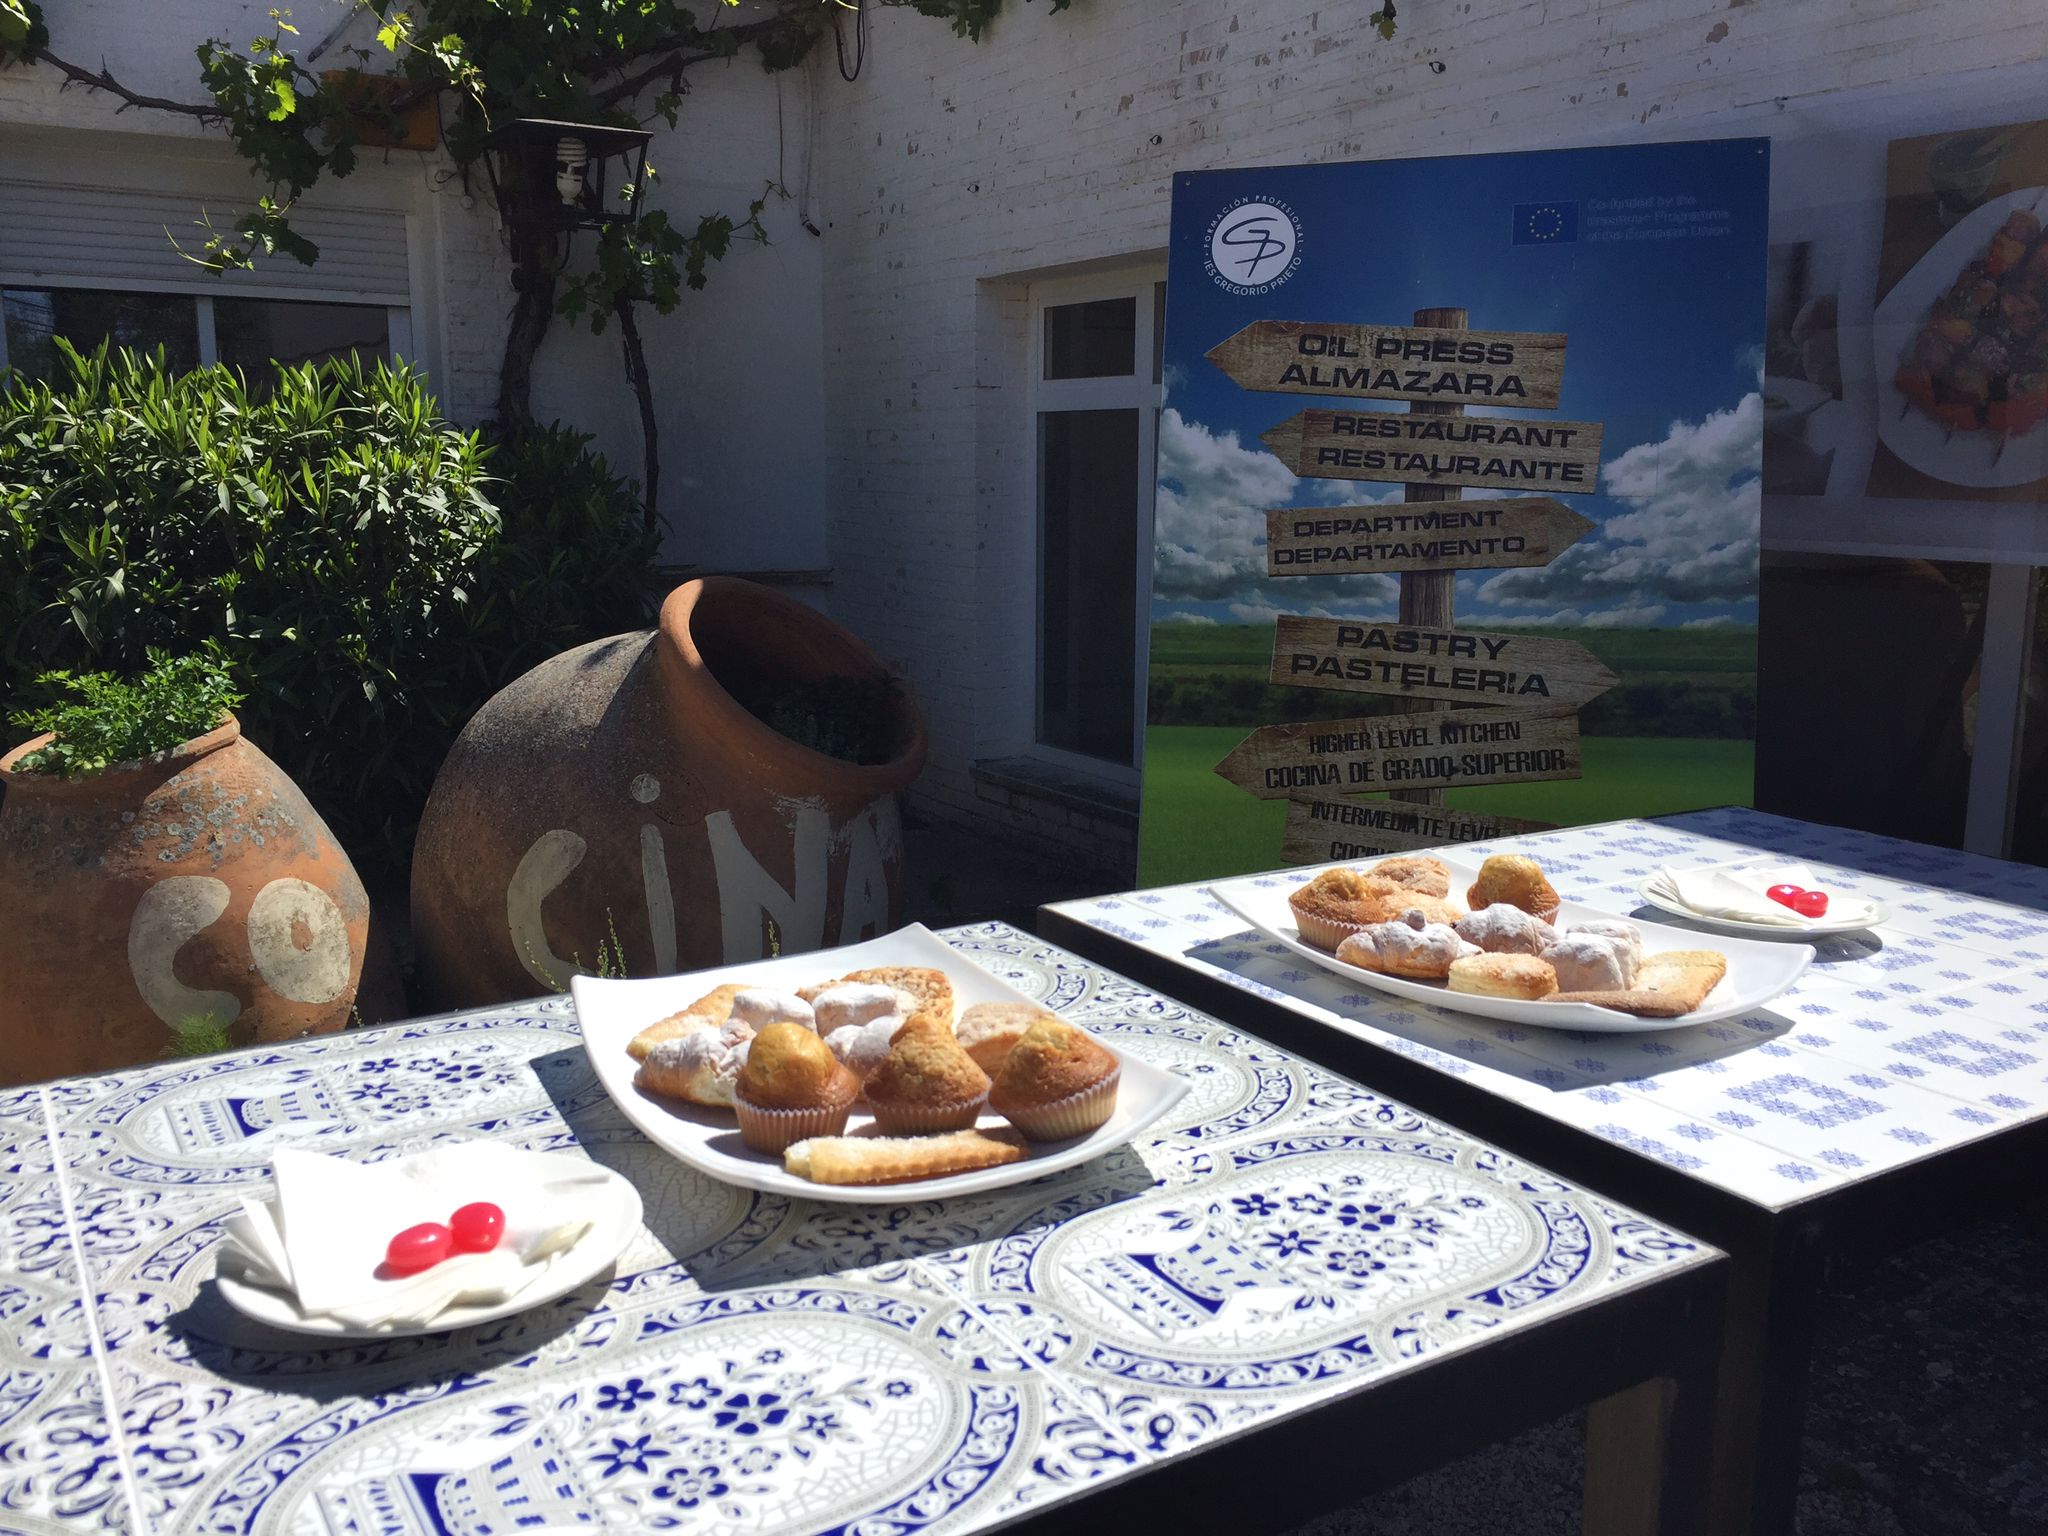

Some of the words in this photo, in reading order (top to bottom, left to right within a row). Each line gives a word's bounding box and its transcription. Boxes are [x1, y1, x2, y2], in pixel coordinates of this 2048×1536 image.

[1255, 195, 1304, 243] PROFESIONAL
[1203, 260, 1217, 277] IES
[1214, 275, 1268, 296] GREGORIO
[1270, 257, 1302, 290] PRIETO
[1299, 334, 1359, 358] OIL
[1375, 338, 1515, 365] PRESS
[1278, 364, 1527, 398] ALMAZARA
[1332, 416, 1578, 449] RESTAURANT
[1317, 447, 1585, 482] RESTAURANTE
[1294, 510, 1504, 537] DEPARTMENT
[1274, 536, 1526, 565] DEPARTAMENTO
[1336, 626, 1511, 661] PASTRY
[1291, 653, 1550, 697] PASTELERIA
[1309, 731, 1372, 754] HIGHER
[1378, 727, 1433, 749] LEVEL
[1440, 721, 1521, 746] KITCHEN
[1265, 764, 1342, 789] COCINA
[1349, 761, 1376, 784] DE
[1383, 756, 1451, 781] GRADO
[1461, 749, 1567, 777] SUPERIOR
[1310, 801, 1443, 838] INTERMEDIATE
[127, 875, 350, 1032] CO
